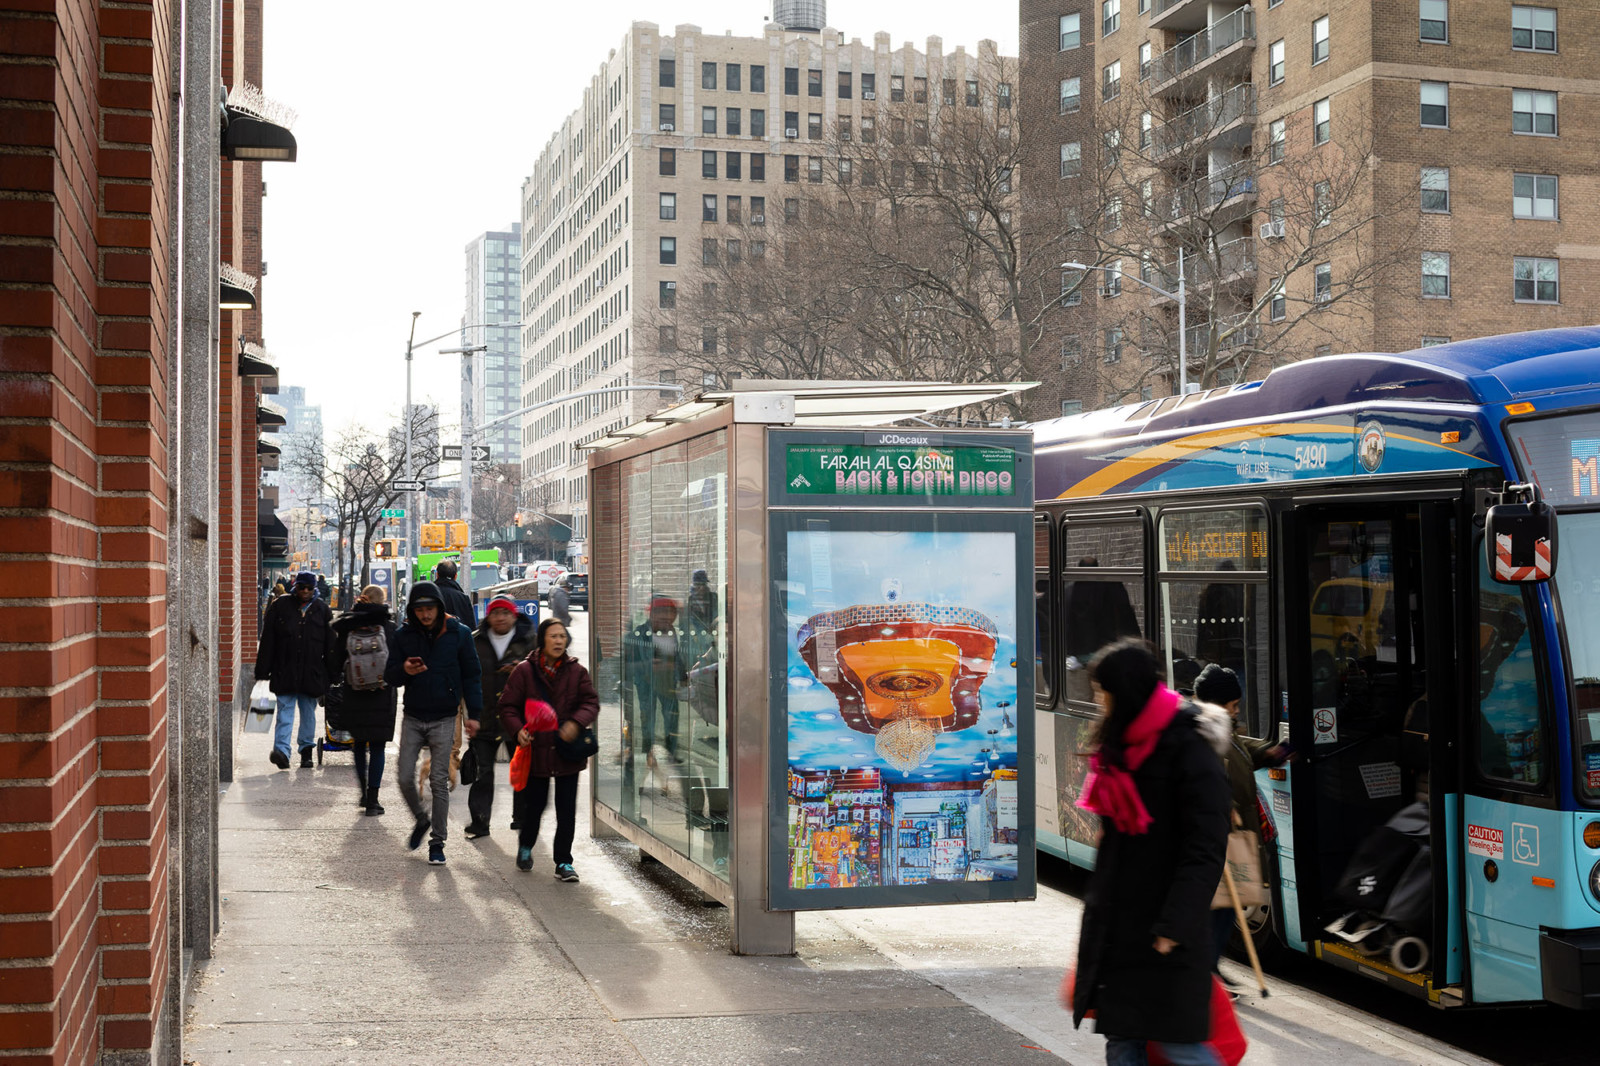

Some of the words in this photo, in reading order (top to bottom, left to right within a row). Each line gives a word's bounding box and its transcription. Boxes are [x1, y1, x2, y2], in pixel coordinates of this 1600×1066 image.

[879, 434, 929, 445] JCDecaux
[820, 455, 871, 470] FARAH
[874, 455, 894, 470] AL
[897, 455, 954, 470] QASIMI
[1294, 443, 1327, 470] 5490
[1236, 463, 1251, 475] WIFI
[1254, 461, 1270, 473] USB
[835, 470, 882, 487] BACK
[886, 470, 898, 487] &
[903, 470, 954, 487] FORTH
[959, 471, 1012, 488] DISCO
[1468, 825, 1503, 842] CAUTION
[1469, 839, 1491, 852] Kneeling
[1493, 843, 1503, 853] Bus
